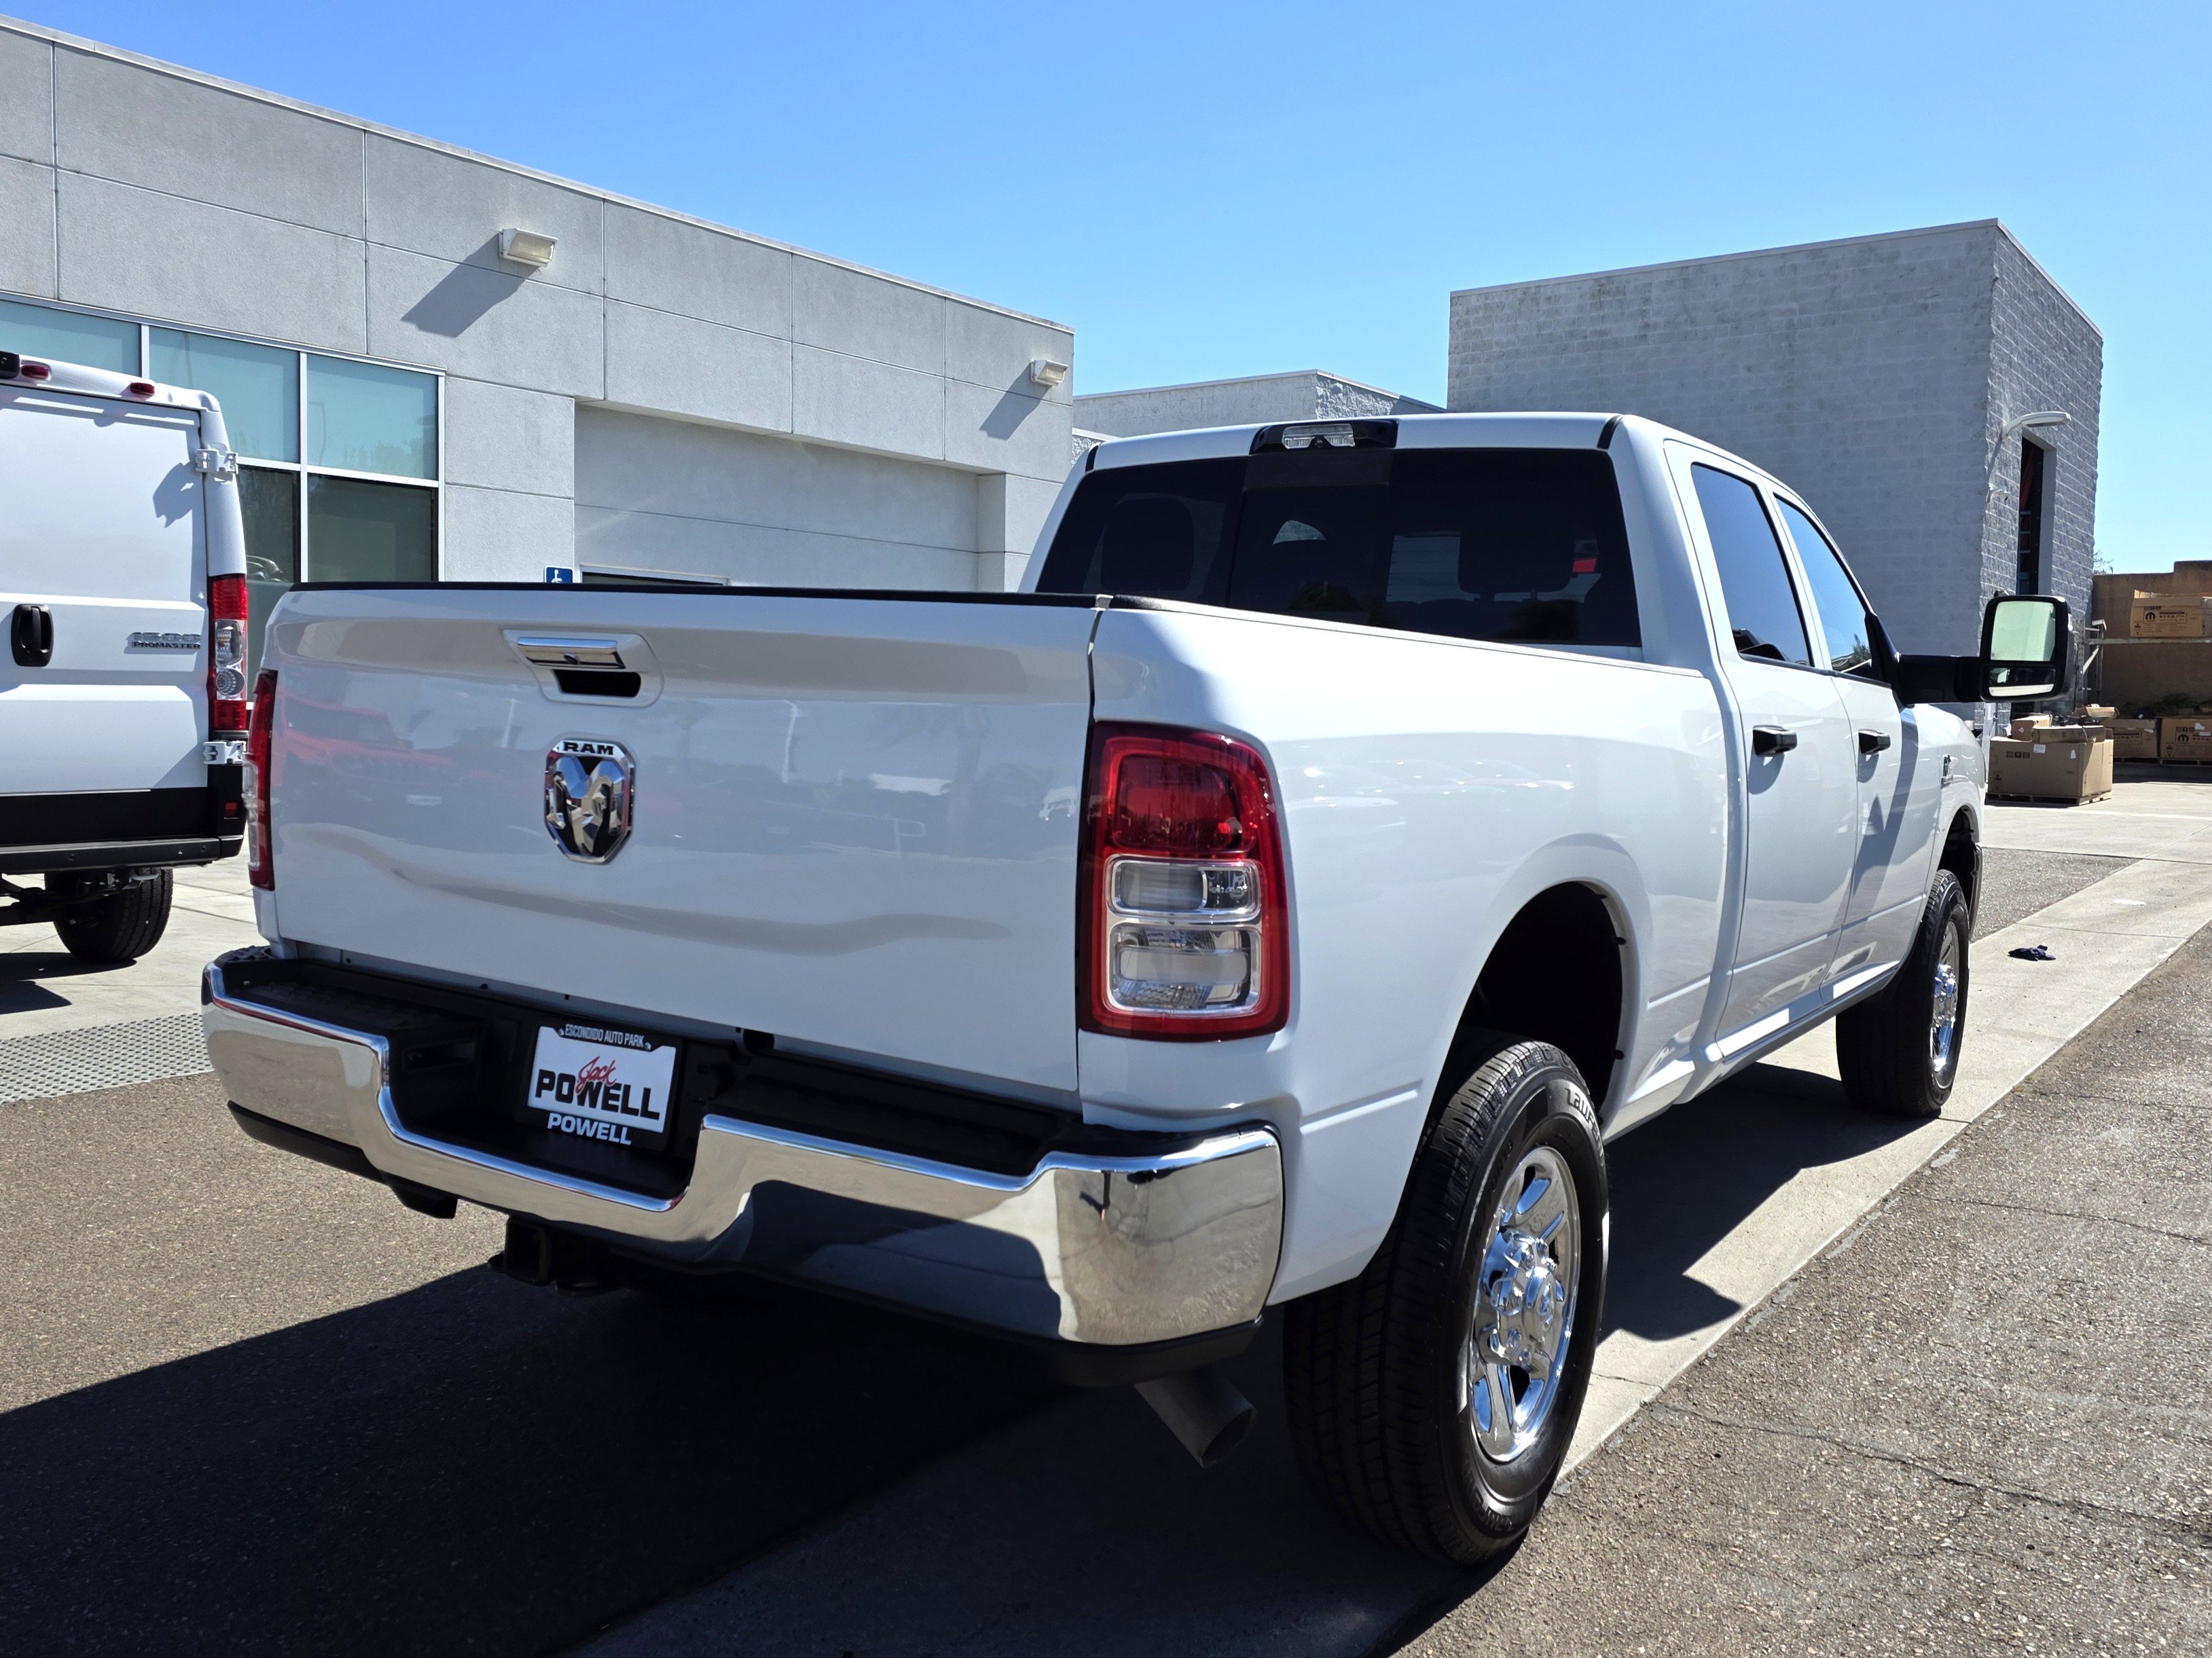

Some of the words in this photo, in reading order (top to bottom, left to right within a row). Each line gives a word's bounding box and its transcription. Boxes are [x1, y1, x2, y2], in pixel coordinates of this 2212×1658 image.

[563, 741, 615, 756] RAM
[565, 1024, 603, 1041] ESCONDIDO
[604, 1030, 623, 1045] AUTO
[624, 1033, 645, 1048] PARK
[575, 1056, 617, 1094] Jack
[534, 1069, 660, 1120] POWELL
[547, 1112, 632, 1145] POWELL
